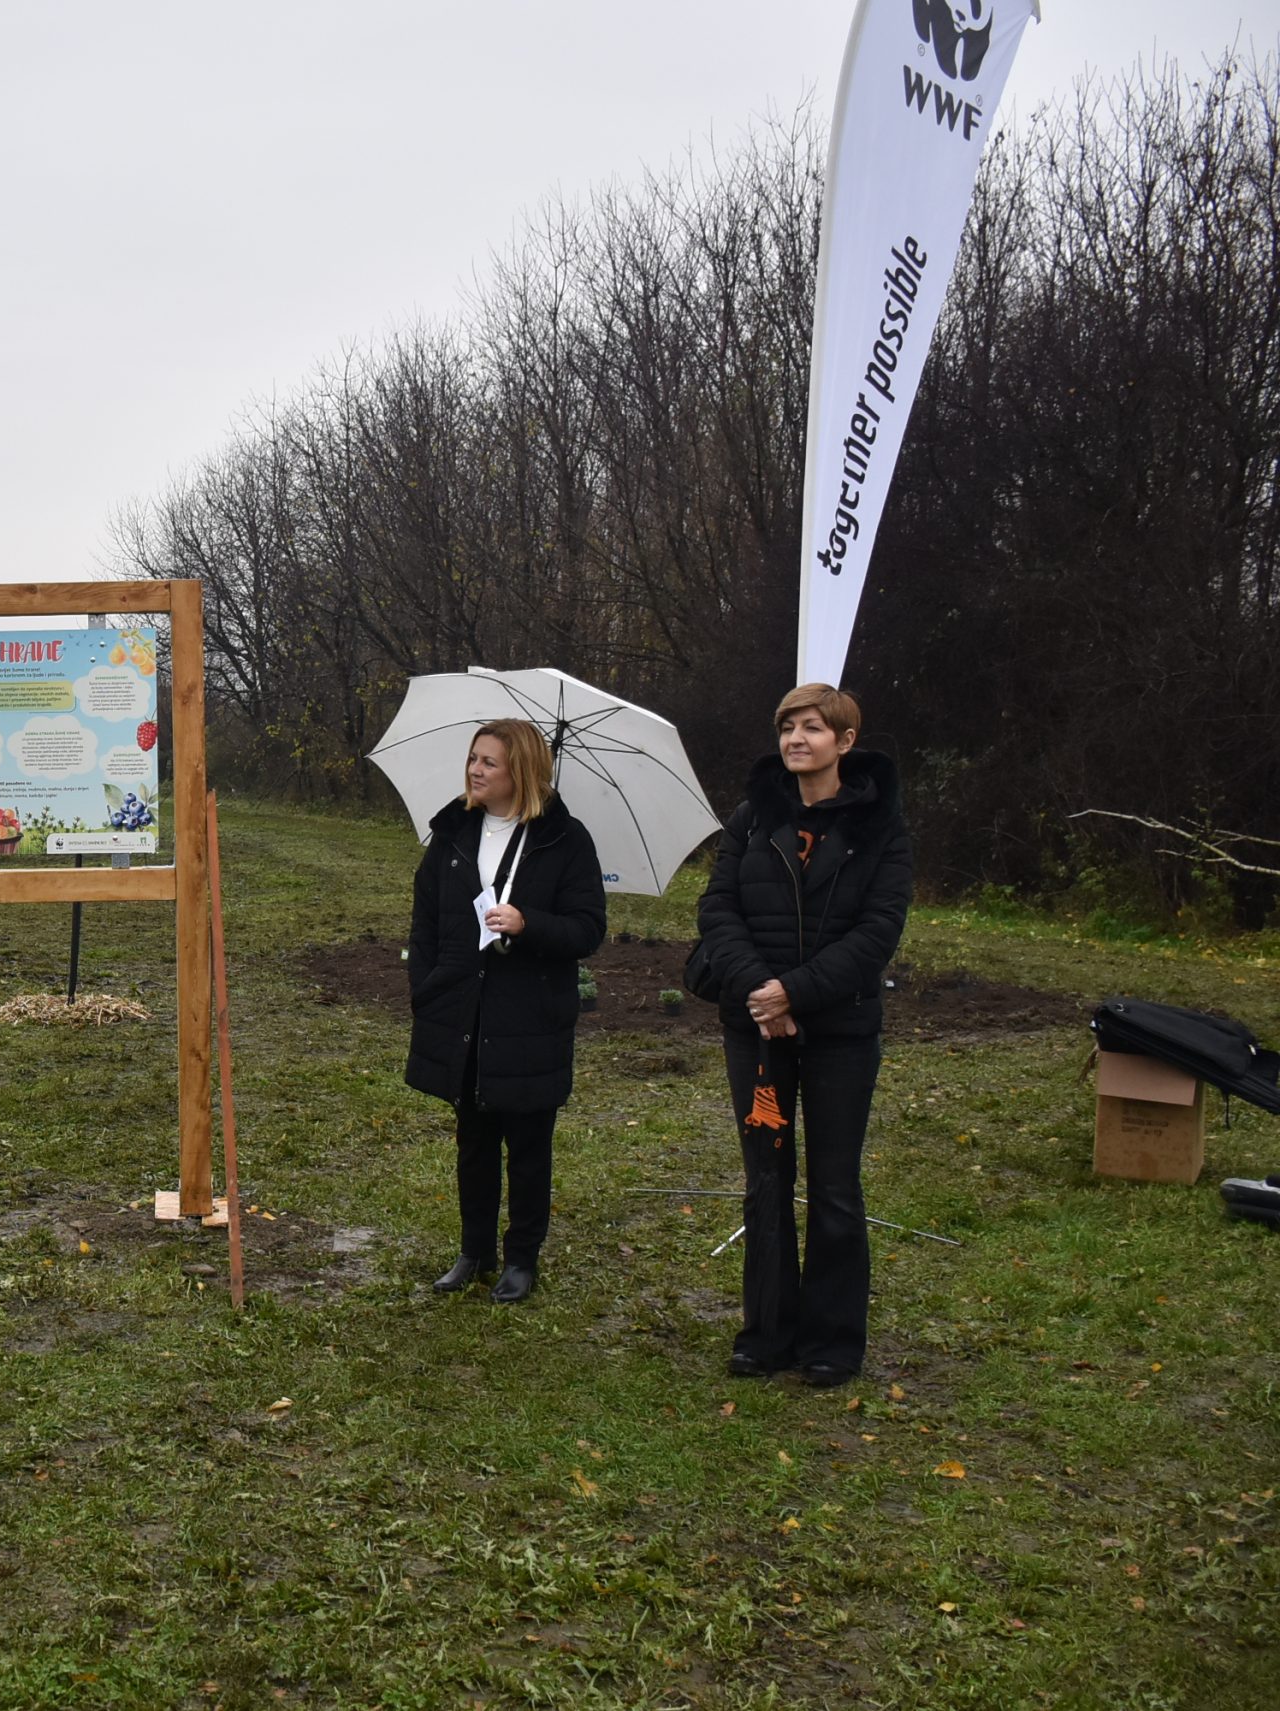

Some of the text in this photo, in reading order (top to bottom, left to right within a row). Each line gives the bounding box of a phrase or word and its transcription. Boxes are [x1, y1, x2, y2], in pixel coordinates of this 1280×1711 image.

[903, 64, 983, 142] WWF
[864, 235, 927, 403] possible
[0, 640, 64, 664] HRANE
